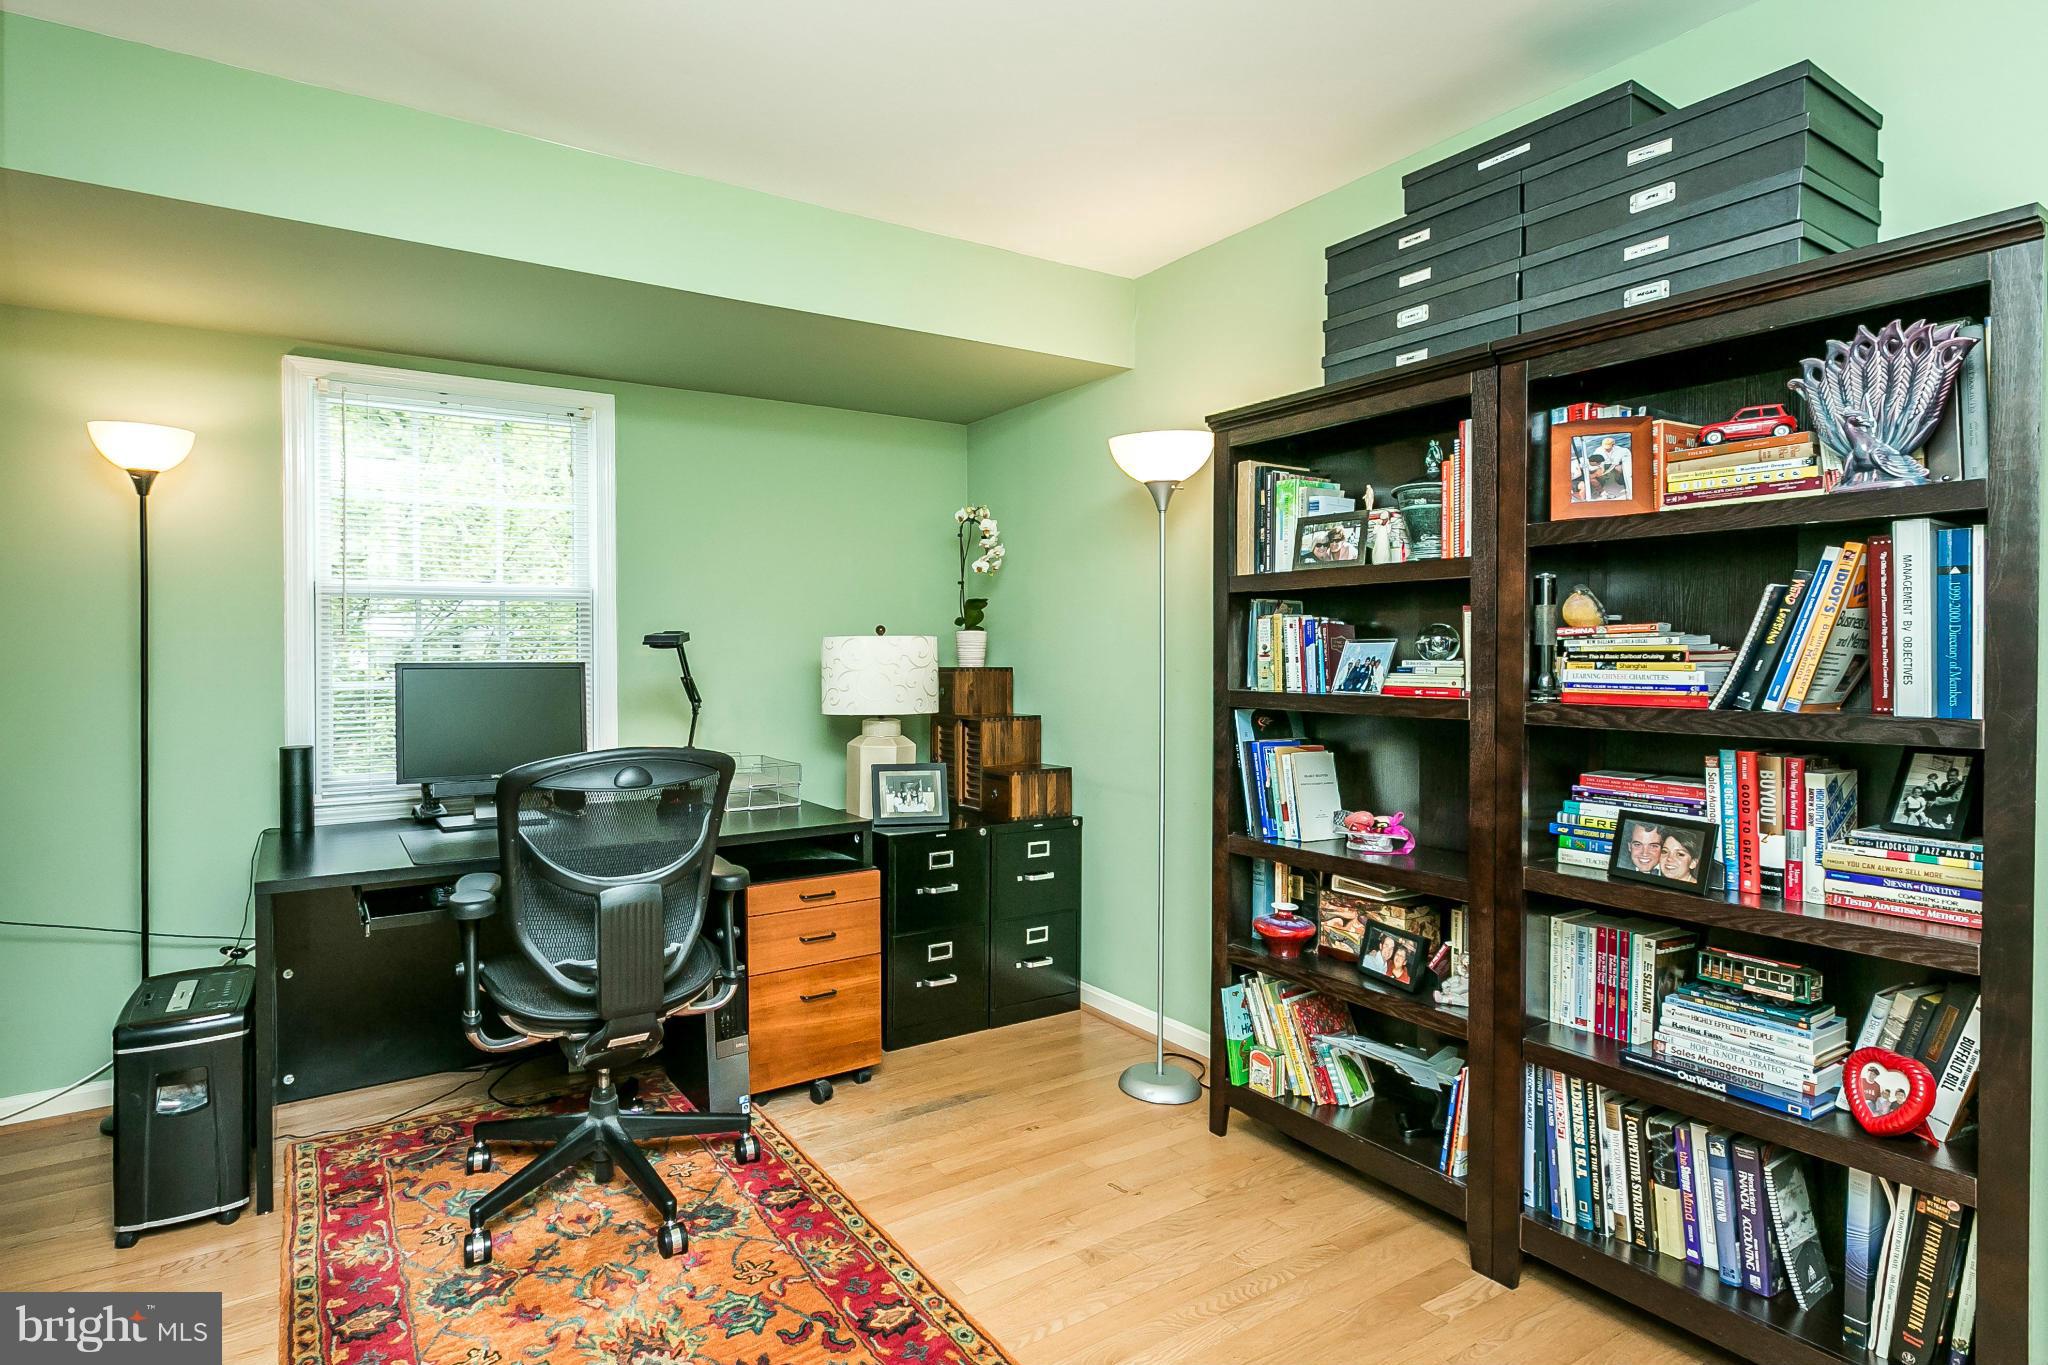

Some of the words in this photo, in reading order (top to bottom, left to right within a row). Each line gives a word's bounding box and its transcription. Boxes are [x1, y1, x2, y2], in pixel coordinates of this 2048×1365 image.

[1823, 568, 1850, 614] IDIOT'S
[1902, 554, 1913, 616] MANAGEMENT
[1948, 581, 1962, 623] 1999-2000
[1564, 627, 1596, 635] CHINA
[1765, 607, 1791, 645] LOUISIANA
[1639, 652, 1665, 662] Cruising
[1810, 623, 1830, 661] Business
[1945, 624, 1962, 660] Directory
[1619, 662, 1648, 671] Shanghai
[1795, 648, 1813, 680] Memos
[1903, 636, 1913, 686] OBJECTIVES
[1949, 661, 1962, 671] of
[1572, 672, 1601, 681] LEARNING
[1601, 673, 1629, 681] CHINESE
[1797, 663, 1816, 695] Letters
[1948, 671, 1962, 707] Members
[1707, 771, 1718, 794] Sales
[1723, 763, 1733, 785] BLUE
[1723, 787, 1734, 816] OCEAN
[1741, 784, 1751, 815] GOOD
[1759, 769, 1777, 826] BUYOUT
[1815, 788, 1825, 804] HIGH
[1743, 819, 1751, 834] TO
[1815, 803, 1825, 826] OUTPUT
[1724, 818, 1736, 861] STRATEGY
[1813, 826, 1824, 867] MANAGEMENT
[1875, 840, 1919, 854] LEADERSHIP
[1921, 845, 1942, 856] JAZZ
[1946, 848, 1965, 860] MAX
[1743, 839, 1753, 877] GREAT
[1846, 860, 1861, 868] YOU
[1861, 862, 1876, 870] CAN
[1877, 864, 1903, 874] ALWAYS
[1905, 868, 1922, 877] SELL
[1923, 870, 1943, 880] MORE
[1843, 895, 1873, 908] TESTED
[1873, 899, 1926, 918] ADVERTISING
[1926, 909, 1970, 925] METHODS
[1897, 891, 1939, 905] COACHING
[1940, 897, 1960, 907] FOR
[1641, 972, 1653, 1014] SELLING
[1671, 1008, 1677, 1016] 7
[1690, 1013, 1714, 1026] HIGHLY
[1714, 1019, 1749, 1035] EFFECTIVE
[1749, 1029, 1774, 1041] PEOPLE
[1671, 1021, 1703, 1036] Raving
[1703, 1029, 1724, 1041] Fans
[1864, 1030, 1877, 1043] the
[1869, 1019, 1880, 1030] Be
[1911, 1019, 1922, 1036] YEAR
[1670, 1045, 1696, 1061] Sales
[1697, 1052, 1765, 1080] Management
[1690, 1041, 1709, 1055] HOPE
[1711, 1048, 1720, 1056] IS
[1720, 1050, 1739, 1061] NOT
[1739, 1055, 1746, 1063] A
[1749, 1059, 1786, 1075] STRATEGY
[1949, 1035, 1976, 1074] BUFFALO
[1677, 1070, 1699, 1084] Our
[1700, 1076, 1727, 1094] World
[1940, 1072, 1960, 1092] BILL
[1536, 1091, 1544, 1106] JETS
[1570, 1078, 1586, 1145] ILDERNESS
[1586, 1081, 1596, 1118] NATIONAL
[1547, 1103, 1555, 1127] ISLANDS
[1556, 1098, 1567, 1140] AIRCRAFT
[1588, 1118, 1597, 1143] PARKS
[1574, 1147, 1588, 1180] U.S.A.
[1589, 1145, 1598, 1157] OF
[1626, 1119, 1642, 1183] COMPETITIVE
[1679, 1151, 1689, 1166] the
[1592, 1171, 1601, 1201] WORLD
[1680, 1165, 1691, 1193] Sharper
[1712, 1177, 1725, 1201] PUGET
[1737, 1170, 1749, 1211] FINANCIAL
[1747, 1172, 1757, 1207] Introduction
[1631, 1181, 1646, 1233] STRATEGY
[1683, 1190, 1695, 1222] Mind
[1715, 1200, 1728, 1223] SOUND
[1749, 1206, 1758, 1216] to
[1893, 1208, 1906, 1240] NORTHWEST
[1742, 1214, 1756, 1271] ACCOUNTING
[1893, 1240, 1903, 1253] BOAT
[1917, 1220, 1944, 1283] INTERMEDIATE
[1890, 1252, 1901, 1270] TRAVEL
[1886, 1284, 1896, 1301] Edition
[1906, 1280, 1931, 1334] ACCOUNTING
